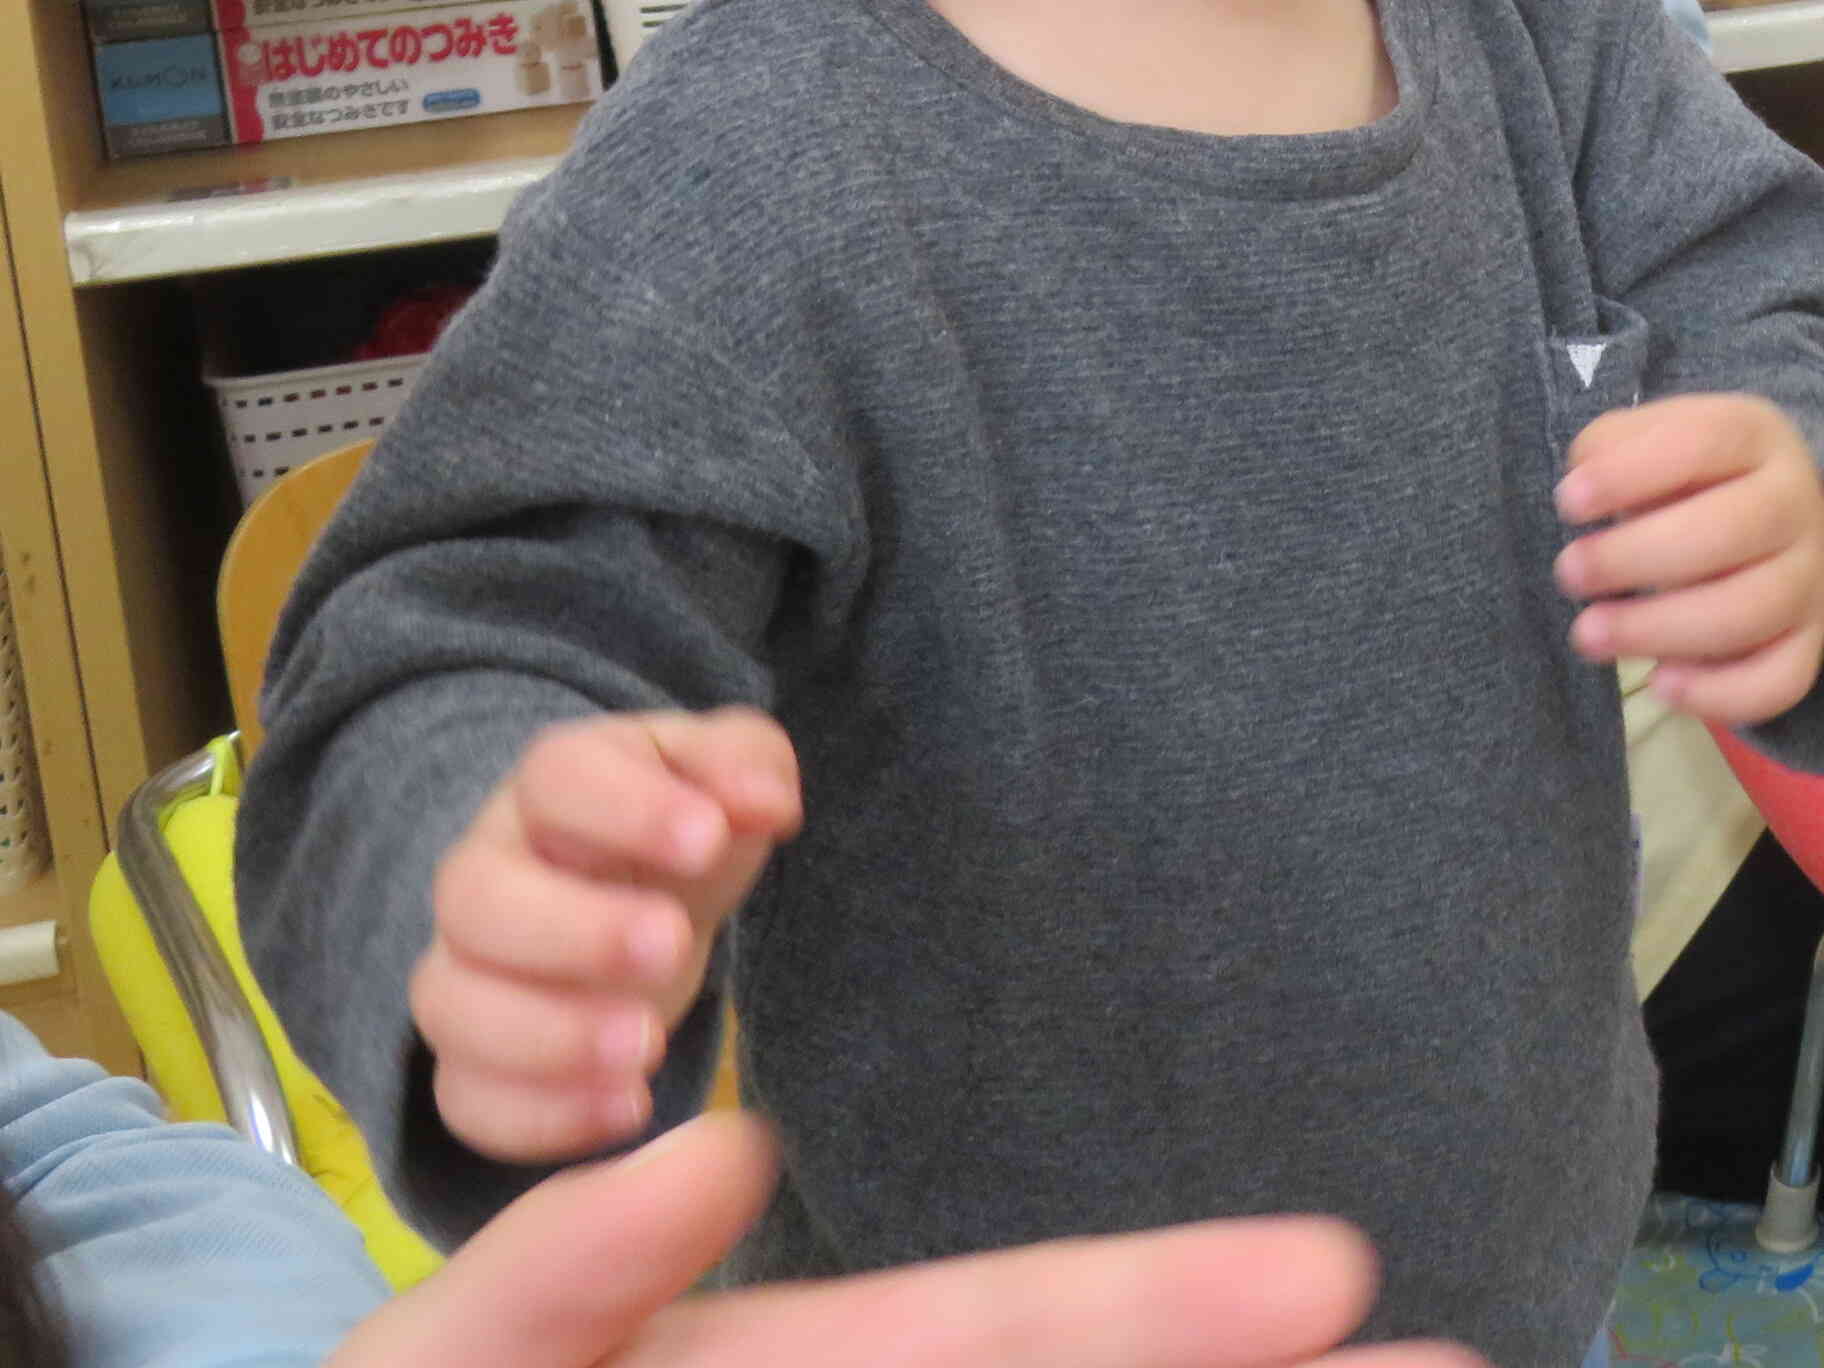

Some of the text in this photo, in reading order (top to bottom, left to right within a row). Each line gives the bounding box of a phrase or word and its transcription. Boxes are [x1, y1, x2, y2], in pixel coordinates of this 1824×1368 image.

[264, 14, 518, 80] はじめてのつみき
